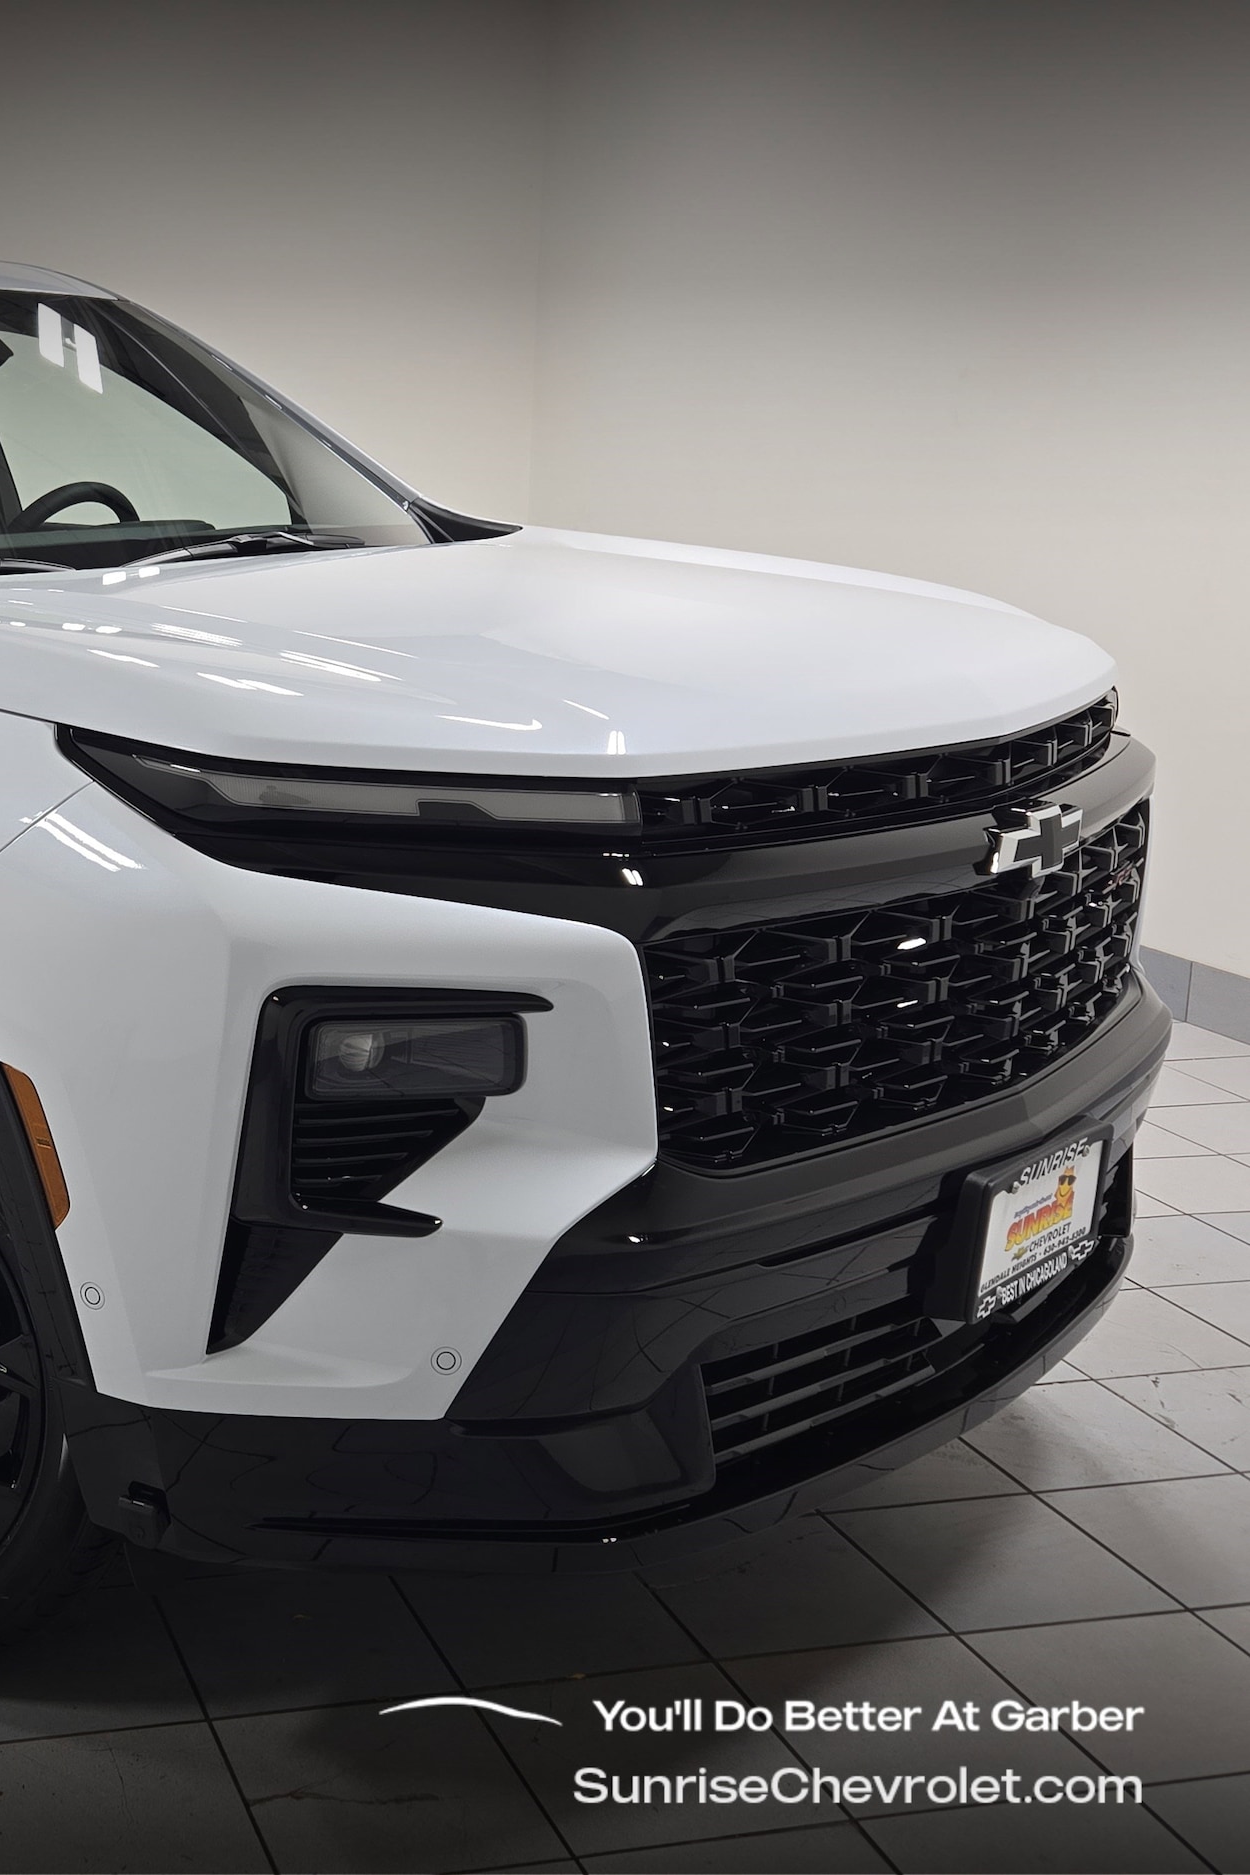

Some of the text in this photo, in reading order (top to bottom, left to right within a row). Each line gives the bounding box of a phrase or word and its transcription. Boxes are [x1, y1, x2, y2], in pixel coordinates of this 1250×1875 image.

[1019, 1137, 1089, 1186] SUNRISE
[1004, 1199, 1073, 1252] SUNRISE
[1028, 1222, 1071, 1252] CHEVROLET
[1001, 1281, 1019, 1305] BEST
[1026, 1252, 1068, 1291] CHICAGOLAND
